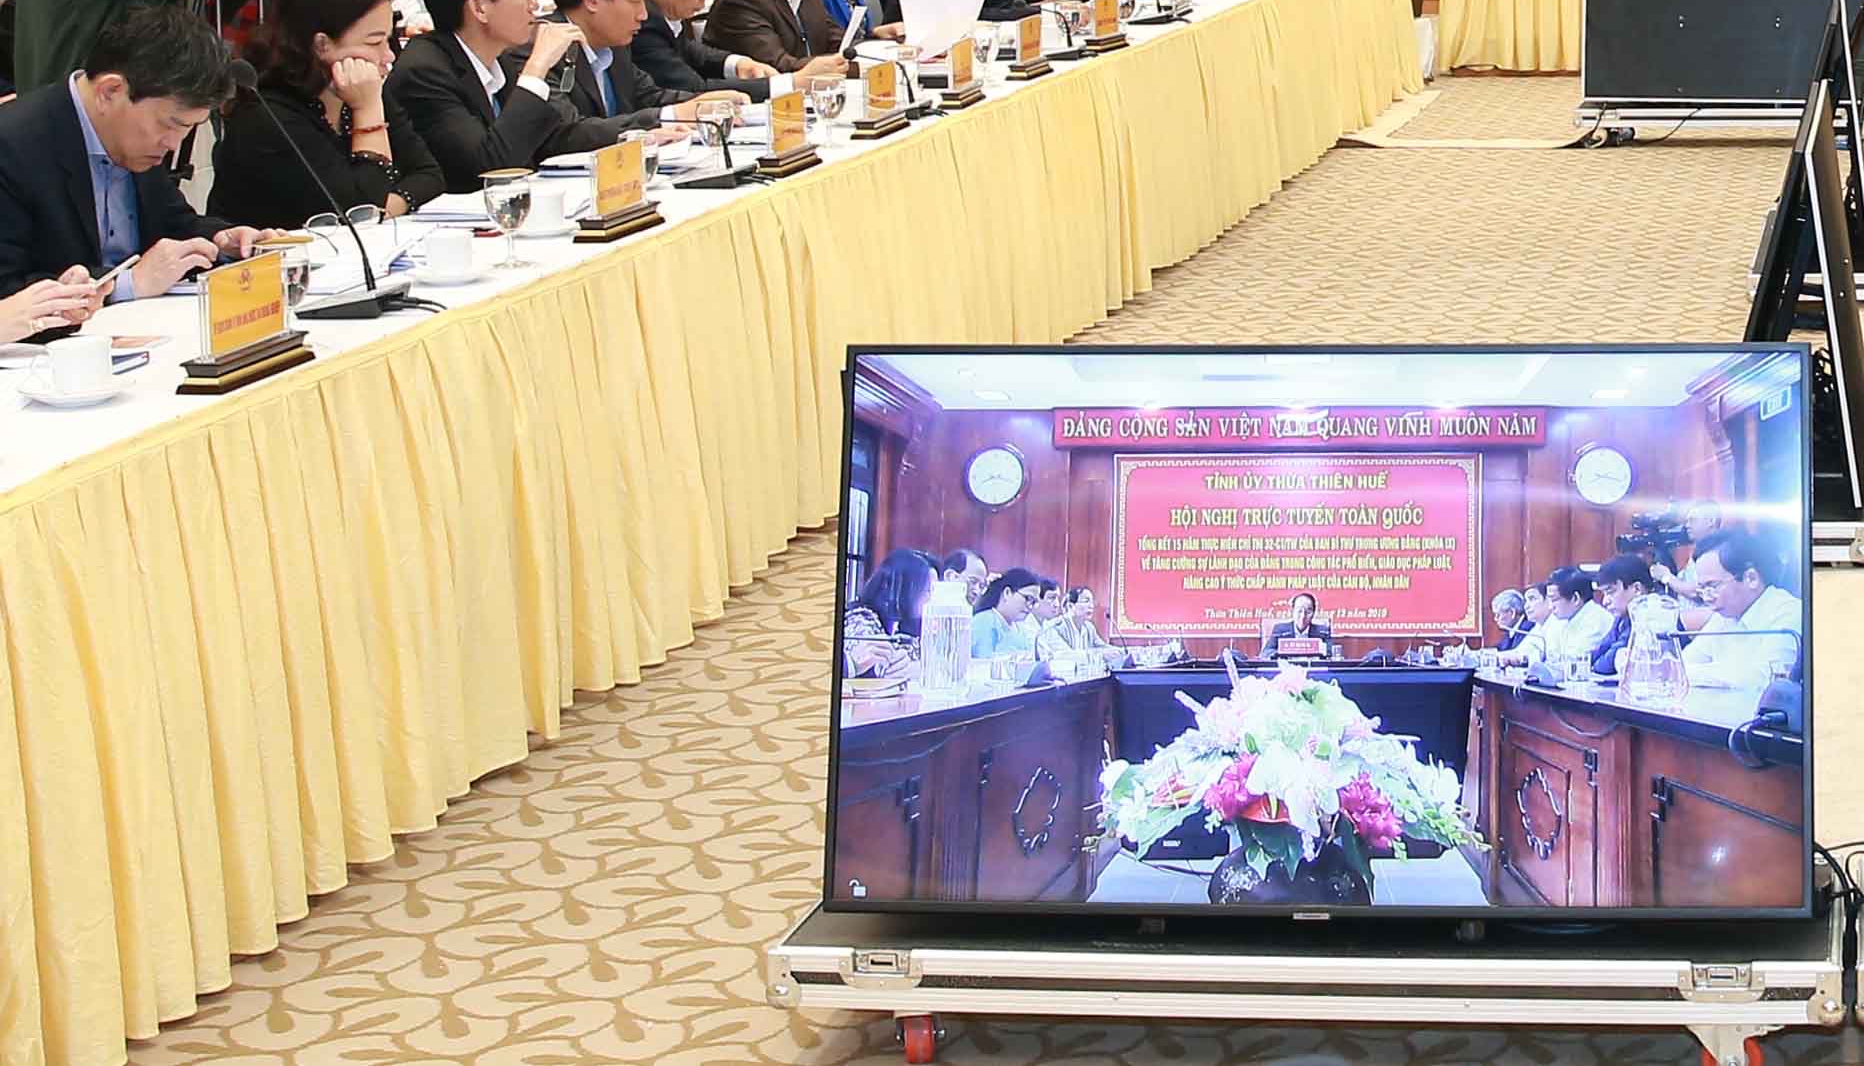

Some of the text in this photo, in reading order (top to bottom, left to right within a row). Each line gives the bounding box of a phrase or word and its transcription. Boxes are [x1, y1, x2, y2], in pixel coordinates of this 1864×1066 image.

[1063, 411, 1112, 438] ĐẢNG
[1119, 413, 1168, 440] CỘNG
[1175, 411, 1210, 437] SẢN
[1219, 412, 1263, 440] VIỆT
[1317, 417, 1378, 440] QUANG
[1384, 414, 1431, 436] VINH
[1439, 413, 1491, 436] MUÔN
[1498, 412, 1537, 435] NĂM
[1205, 471, 1238, 489] TỈNH
[1243, 471, 1265, 489] ỦY
[1312, 472, 1351, 489] THIÊN
[1358, 470, 1389, 488] HUẾ
[1170, 505, 1197, 529] HỘI
[1202, 508, 1238, 529] NGHỊ
[1243, 507, 1282, 529] TRỰC
[1287, 503, 1334, 526] TUYẾN
[1338, 504, 1378, 525] TOÀN
